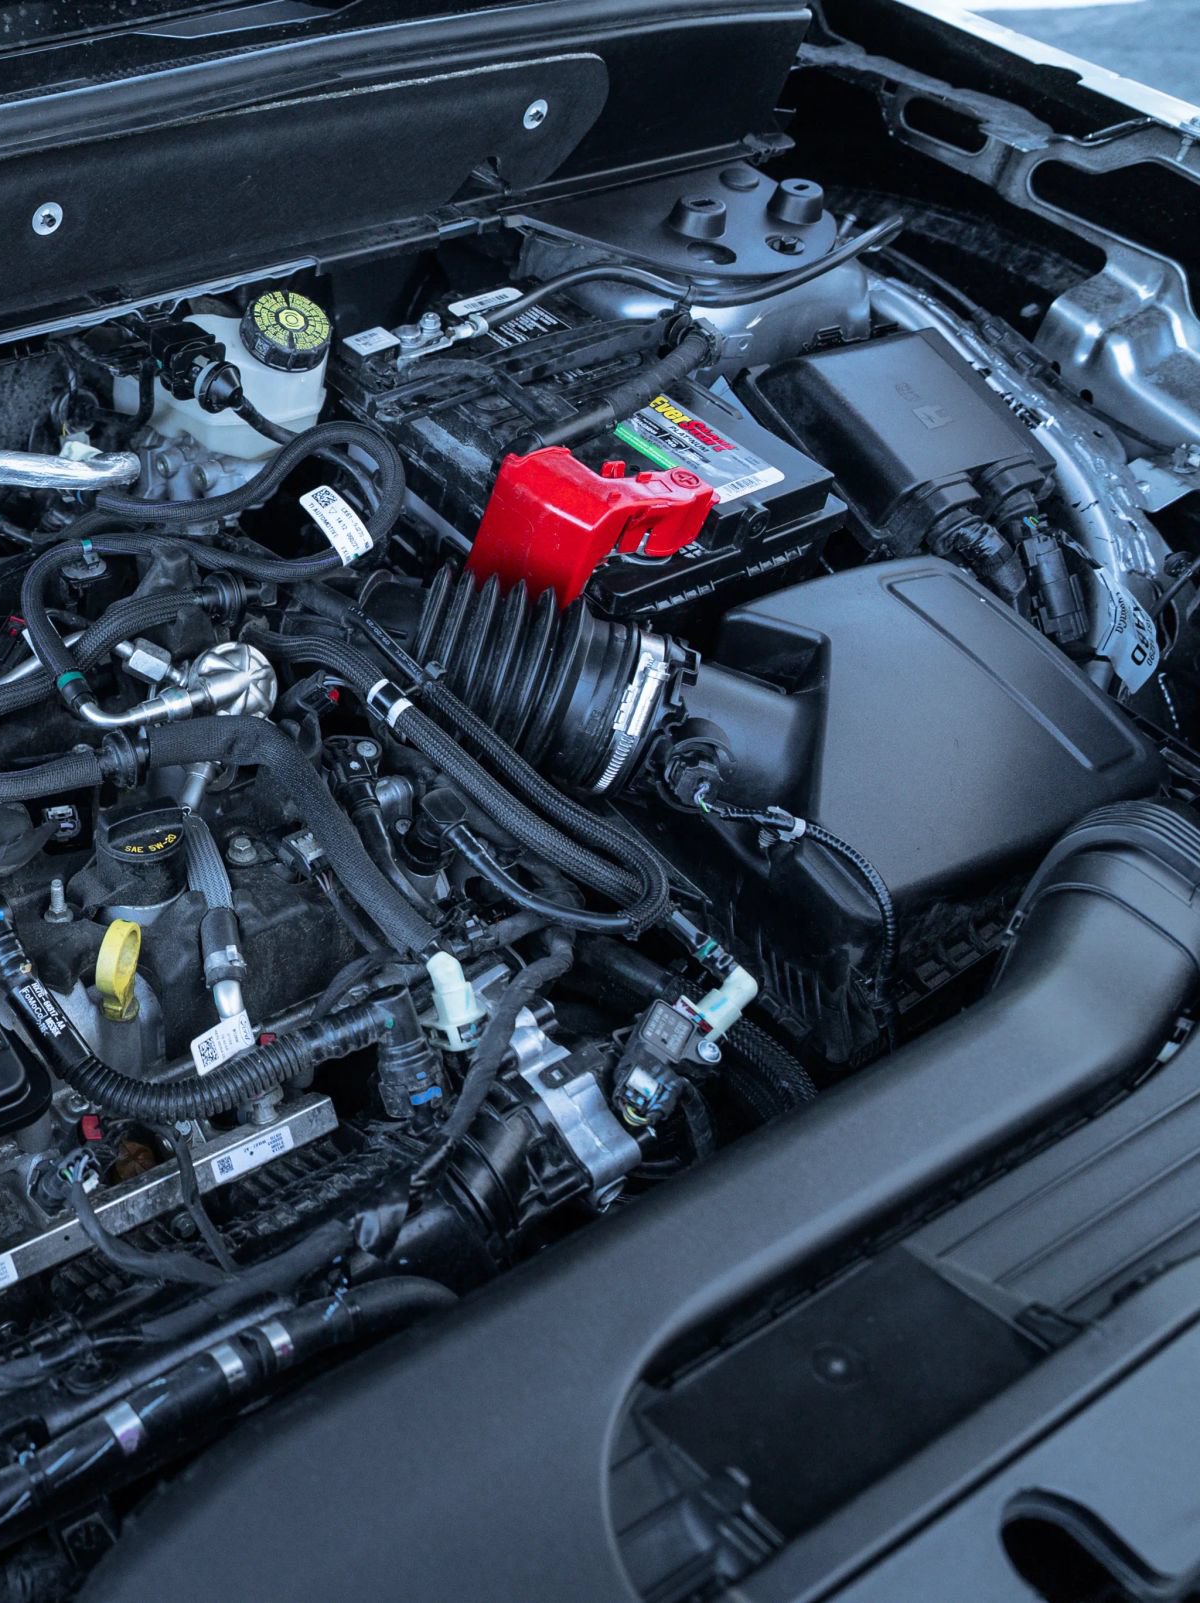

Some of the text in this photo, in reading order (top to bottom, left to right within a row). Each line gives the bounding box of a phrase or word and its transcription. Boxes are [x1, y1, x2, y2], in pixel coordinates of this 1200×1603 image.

[649, 396, 736, 453] EverStart
[124, 845, 144, 853] SAE
[22, 988, 44, 1018] FoMoCo
